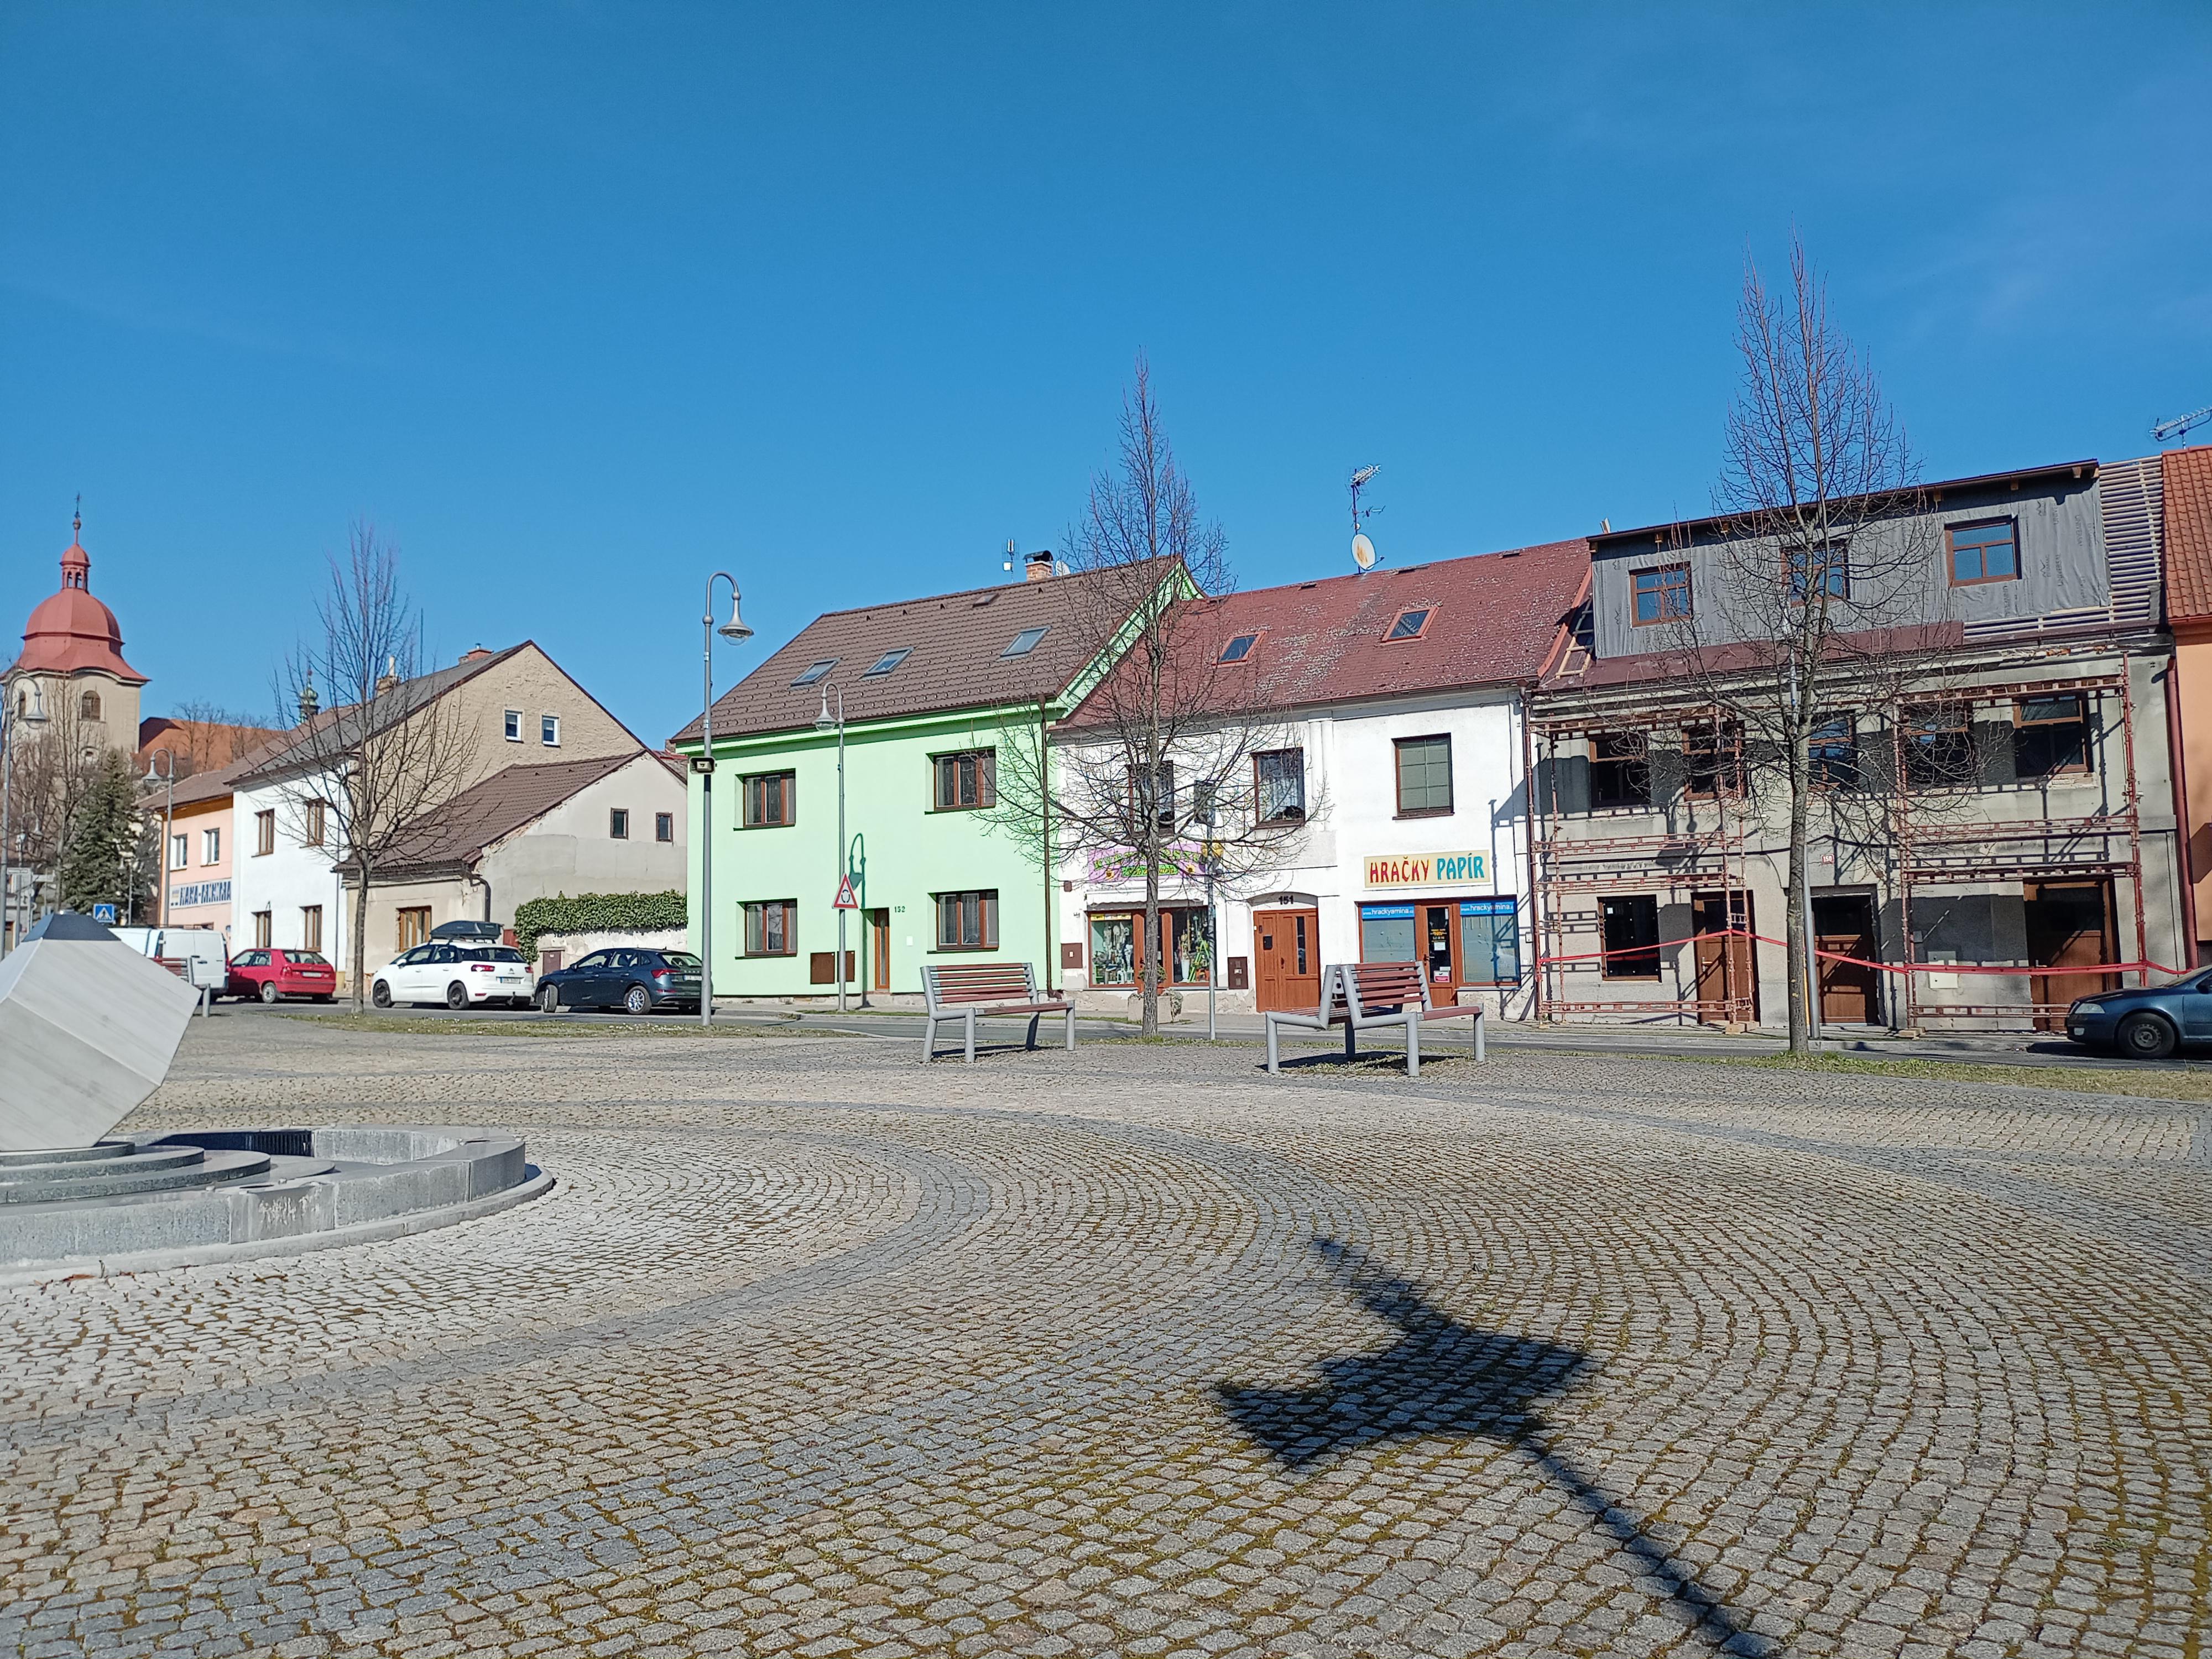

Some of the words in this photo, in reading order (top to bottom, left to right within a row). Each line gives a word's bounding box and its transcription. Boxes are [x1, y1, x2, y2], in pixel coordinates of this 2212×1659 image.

[1370, 856, 1429, 883] HRAČKY
[1437, 853, 1484, 880] PAPÍR
[1279, 895, 1293, 905] 151
